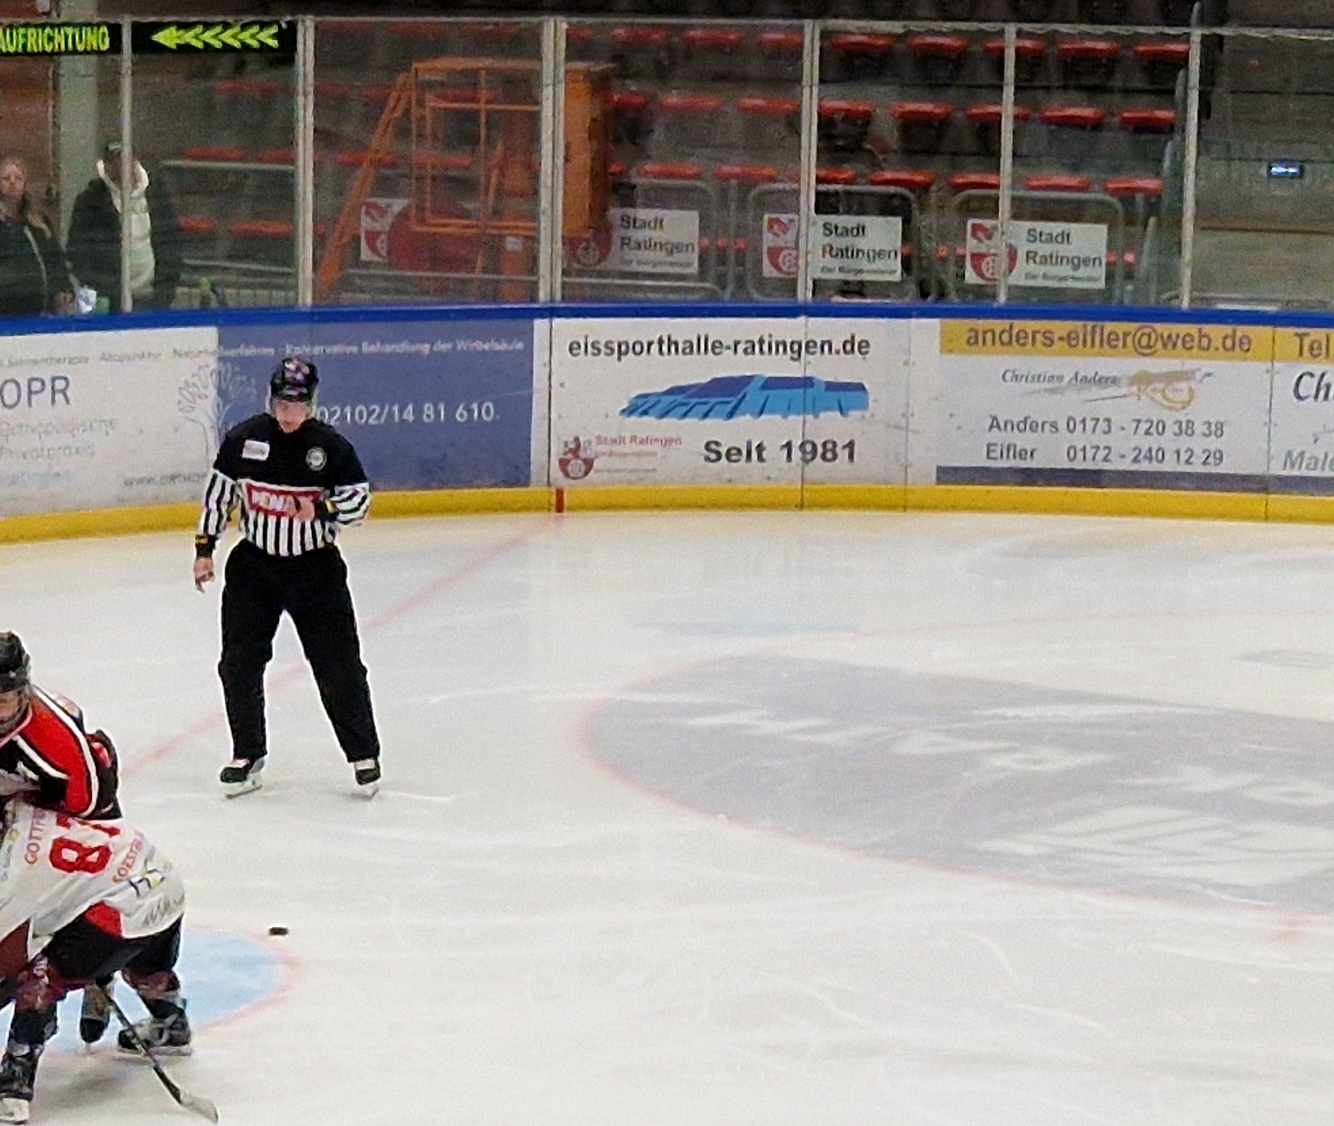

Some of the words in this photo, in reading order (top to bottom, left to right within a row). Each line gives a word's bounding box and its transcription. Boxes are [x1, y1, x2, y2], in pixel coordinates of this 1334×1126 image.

[620, 214, 665, 231] Stadt
[821, 221, 867, 239] Stadt
[620, 237, 696, 256] Ratingen
[1025, 228, 1072, 246] Stadt
[821, 244, 899, 264] Ratingen
[1024, 251, 1104, 271] Ratingen
[568, 333, 871, 360] eissporthalle-ratingen.de
[966, 322, 1252, 354] anders-eifler@web.de
[1001, 368, 1065, 386] Christian
[0, 375, 72, 410] OPR
[423, 401, 446, 423] 81
[987, 415, 1060, 436] Anders
[1065, 416, 1114, 434] 0173
[1131, 418, 1168, 436] 720
[1171, 419, 1195, 437] 38
[1200, 419, 1226, 438] 38
[703, 440, 768, 466] Seit
[779, 439, 858, 464] 1981
[986, 442, 1038, 463] Eifler
[1066, 445, 1113, 463] 0172
[1131, 447, 1168, 465] 240
[1174, 448, 1196, 466] 12
[1200, 448, 1225, 466] 29
